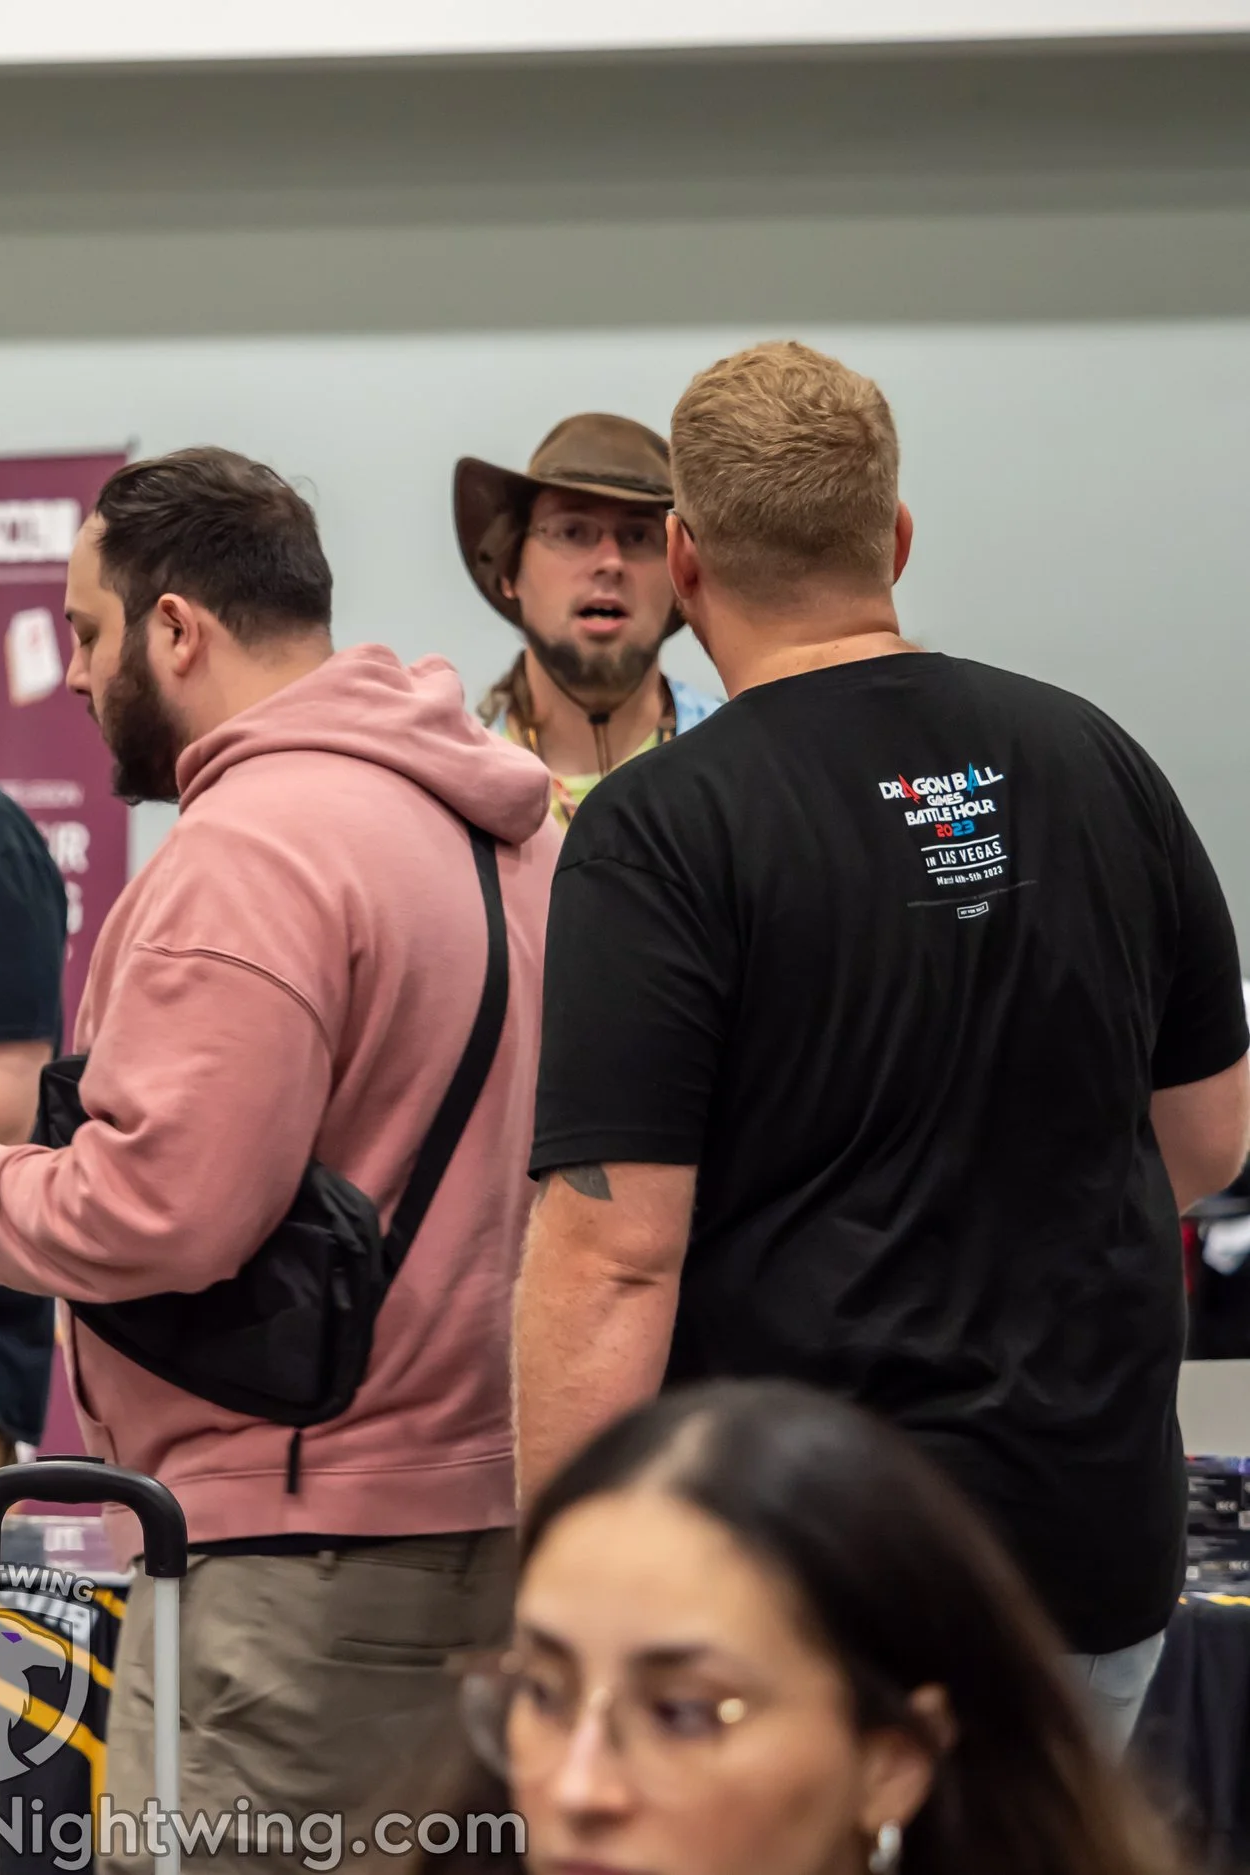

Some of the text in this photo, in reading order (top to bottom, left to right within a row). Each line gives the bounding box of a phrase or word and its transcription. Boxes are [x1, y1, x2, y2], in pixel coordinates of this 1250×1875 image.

[878, 762, 1004, 804] DRAGON BALL
[904, 799, 996, 826] BATTLE HOUR
[935, 819, 975, 837] 2023
[926, 841, 1002, 868] IN LAS VEGAS
[983, 865, 1003, 879] 2023
